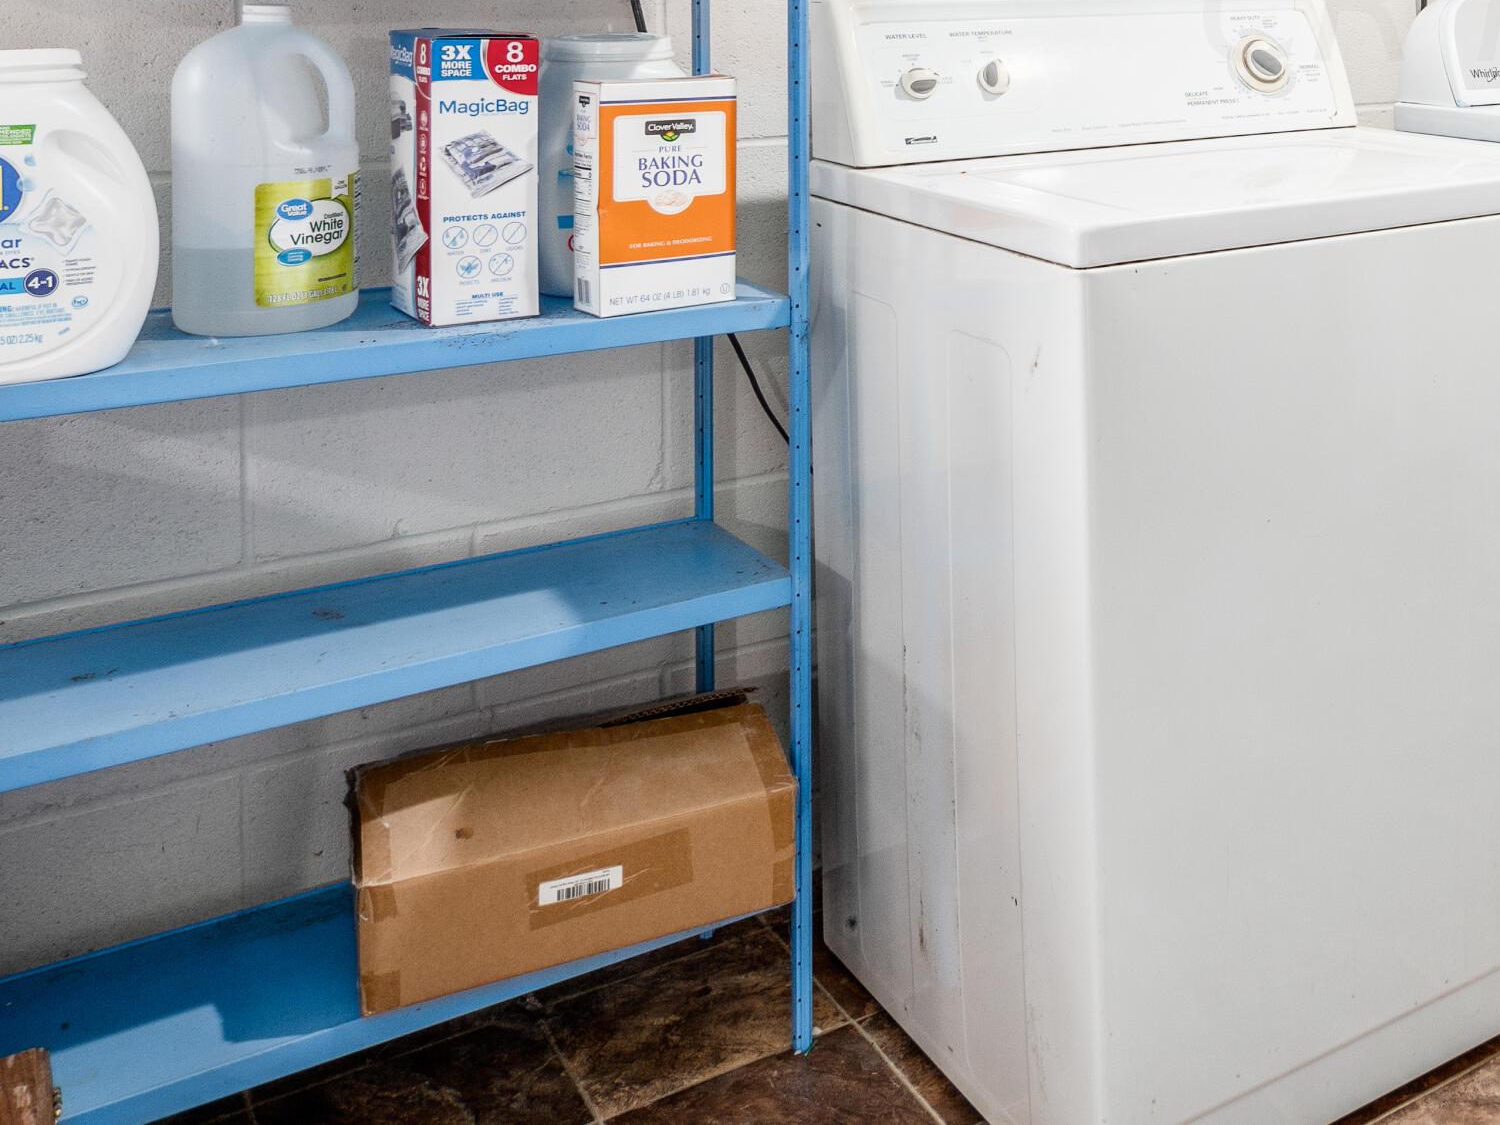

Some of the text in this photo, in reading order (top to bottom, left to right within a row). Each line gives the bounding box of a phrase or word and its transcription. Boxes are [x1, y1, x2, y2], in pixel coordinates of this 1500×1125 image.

[971, 29, 1013, 37] TEMPERATURE
[420, 43, 427, 65] 8
[440, 44, 473, 61] 3X
[506, 41, 525, 63] 8
[441, 60, 472, 70] MORE
[494, 64, 537, 74] COMBO
[441, 69, 472, 77] SPACE
[502, 73, 528, 81] FLATS
[439, 96, 530, 117] MagicBag
[658, 144, 682, 154] PURE
[638, 154, 703, 172] BAKING
[641, 168, 702, 188] SODA
[280, 203, 308, 213] Great
[443, 210, 527, 223] PROTECTS AGAINST
[309, 219, 344, 233] White
[290, 229, 344, 245] Vinegar
[417, 275, 430, 298] 3X
[609, 296, 624, 306] NET
[626, 295, 639, 305] WT
[640, 294, 651, 303] 64
[702, 287, 711, 297] kg
